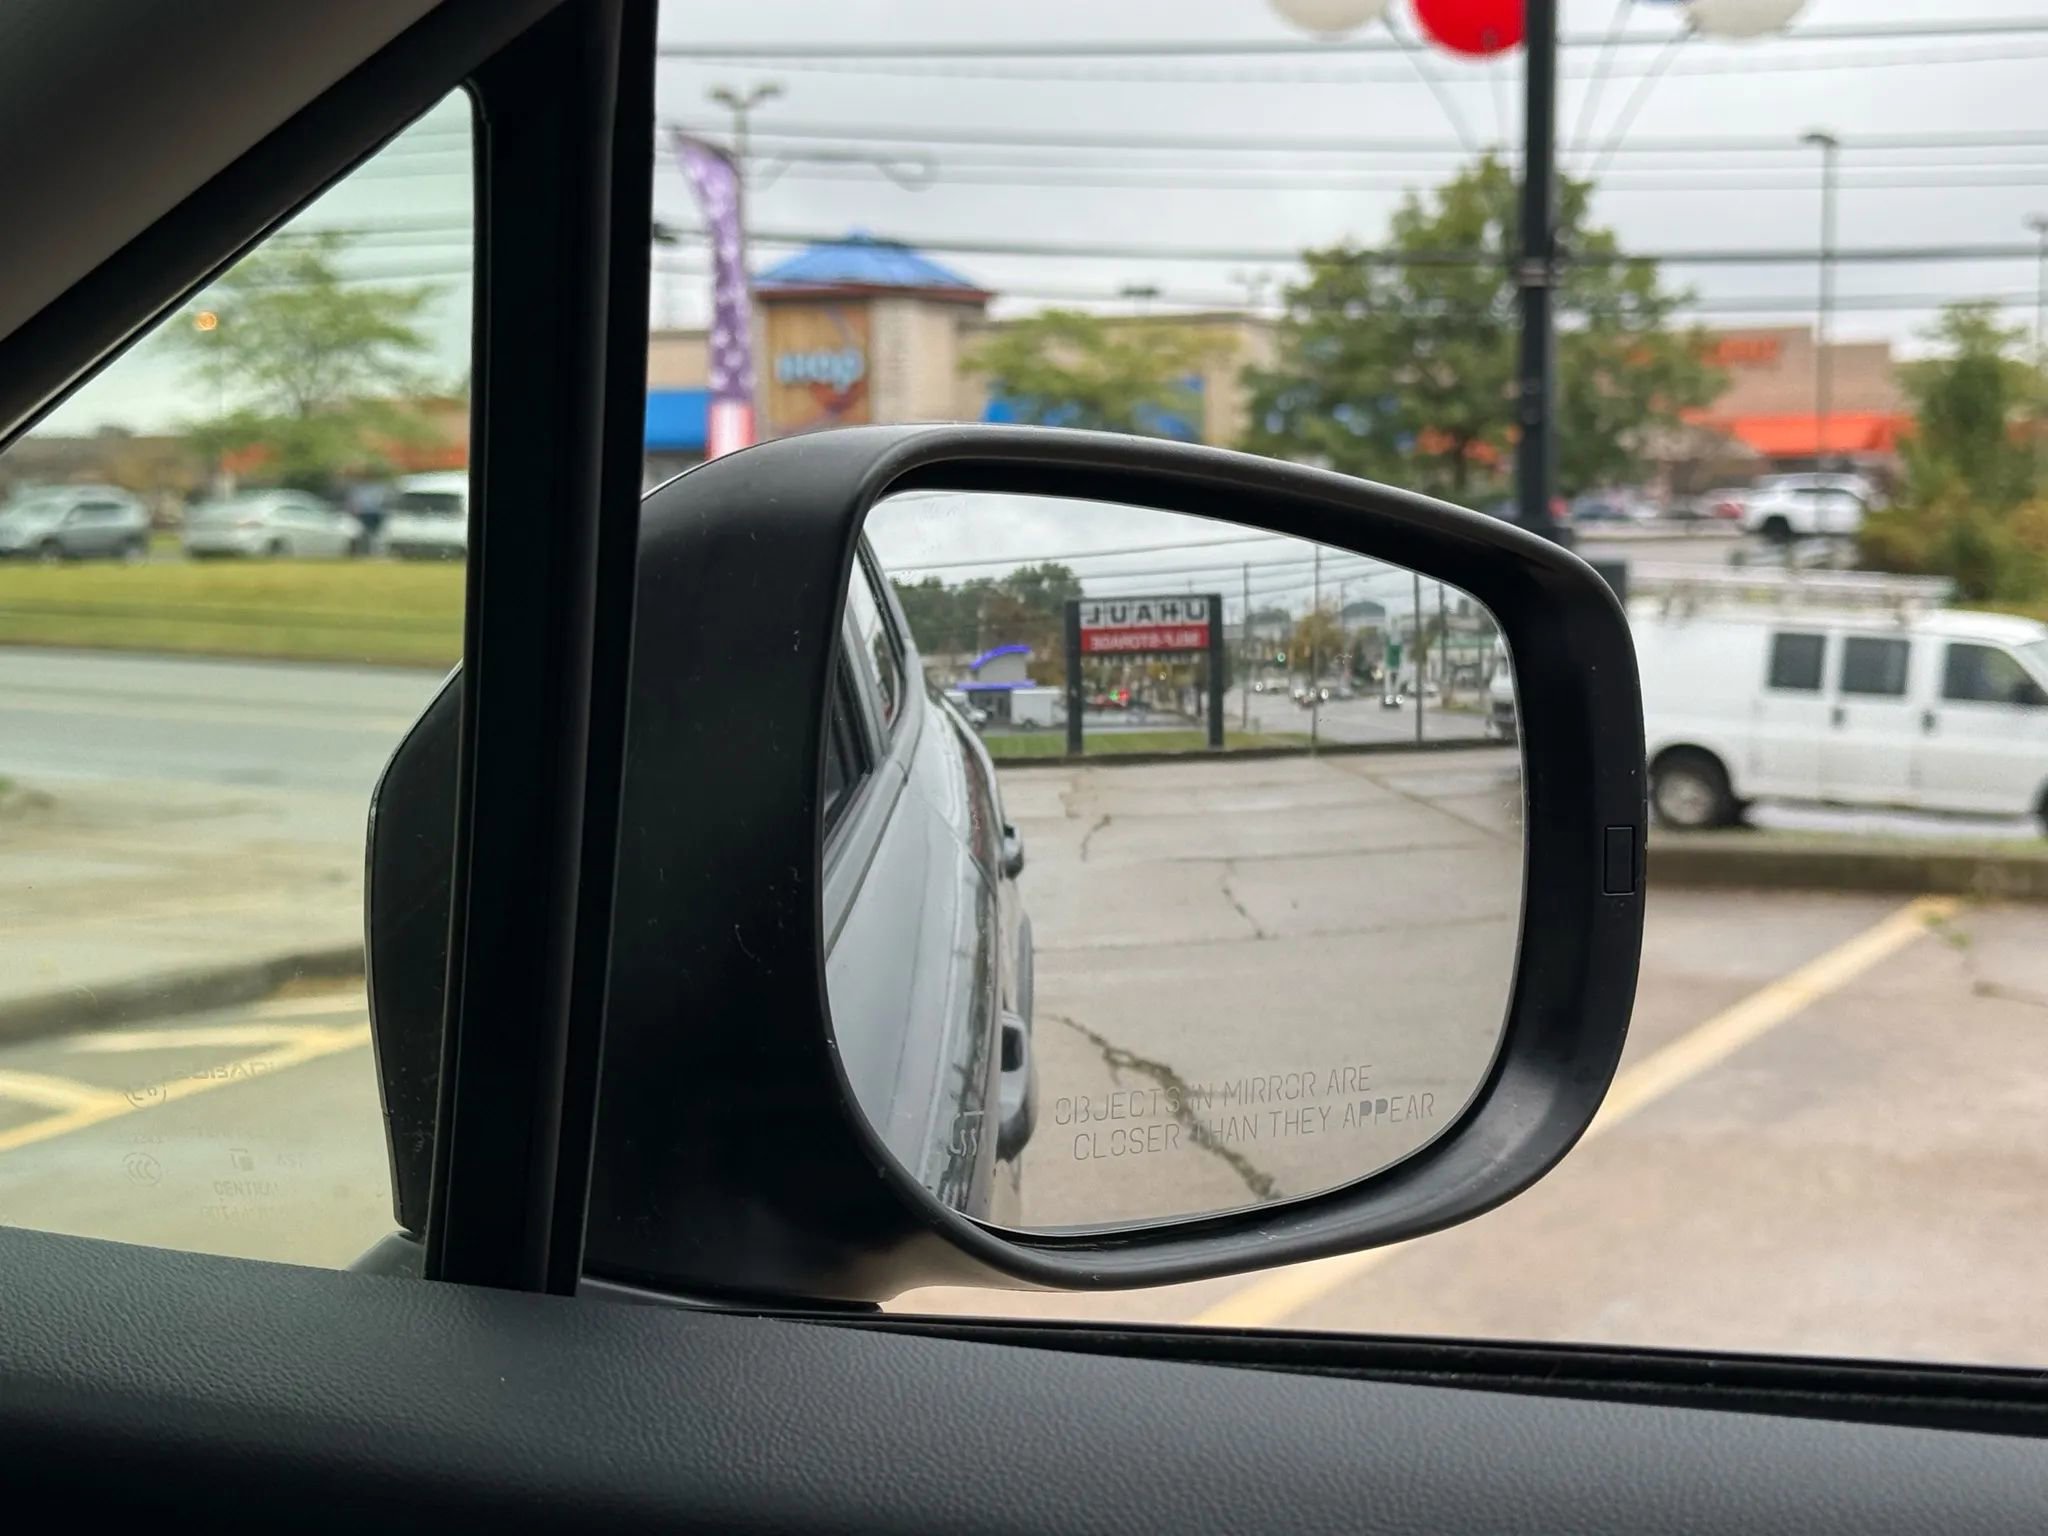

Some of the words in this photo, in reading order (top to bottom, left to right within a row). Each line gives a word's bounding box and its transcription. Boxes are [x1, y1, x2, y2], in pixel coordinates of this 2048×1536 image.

[1055, 1086, 1181, 1126] OBJECTS
[1191, 1081, 1213, 1111] IN
[1224, 1071, 1316, 1107] MIRROR
[1326, 1064, 1373, 1096] ARE
[1073, 1123, 1180, 1161] CLOSER
[1192, 1112, 1258, 1146] THAN
[1268, 1105, 1332, 1138] THEY
[1342, 1092, 1435, 1129] APPEAR
